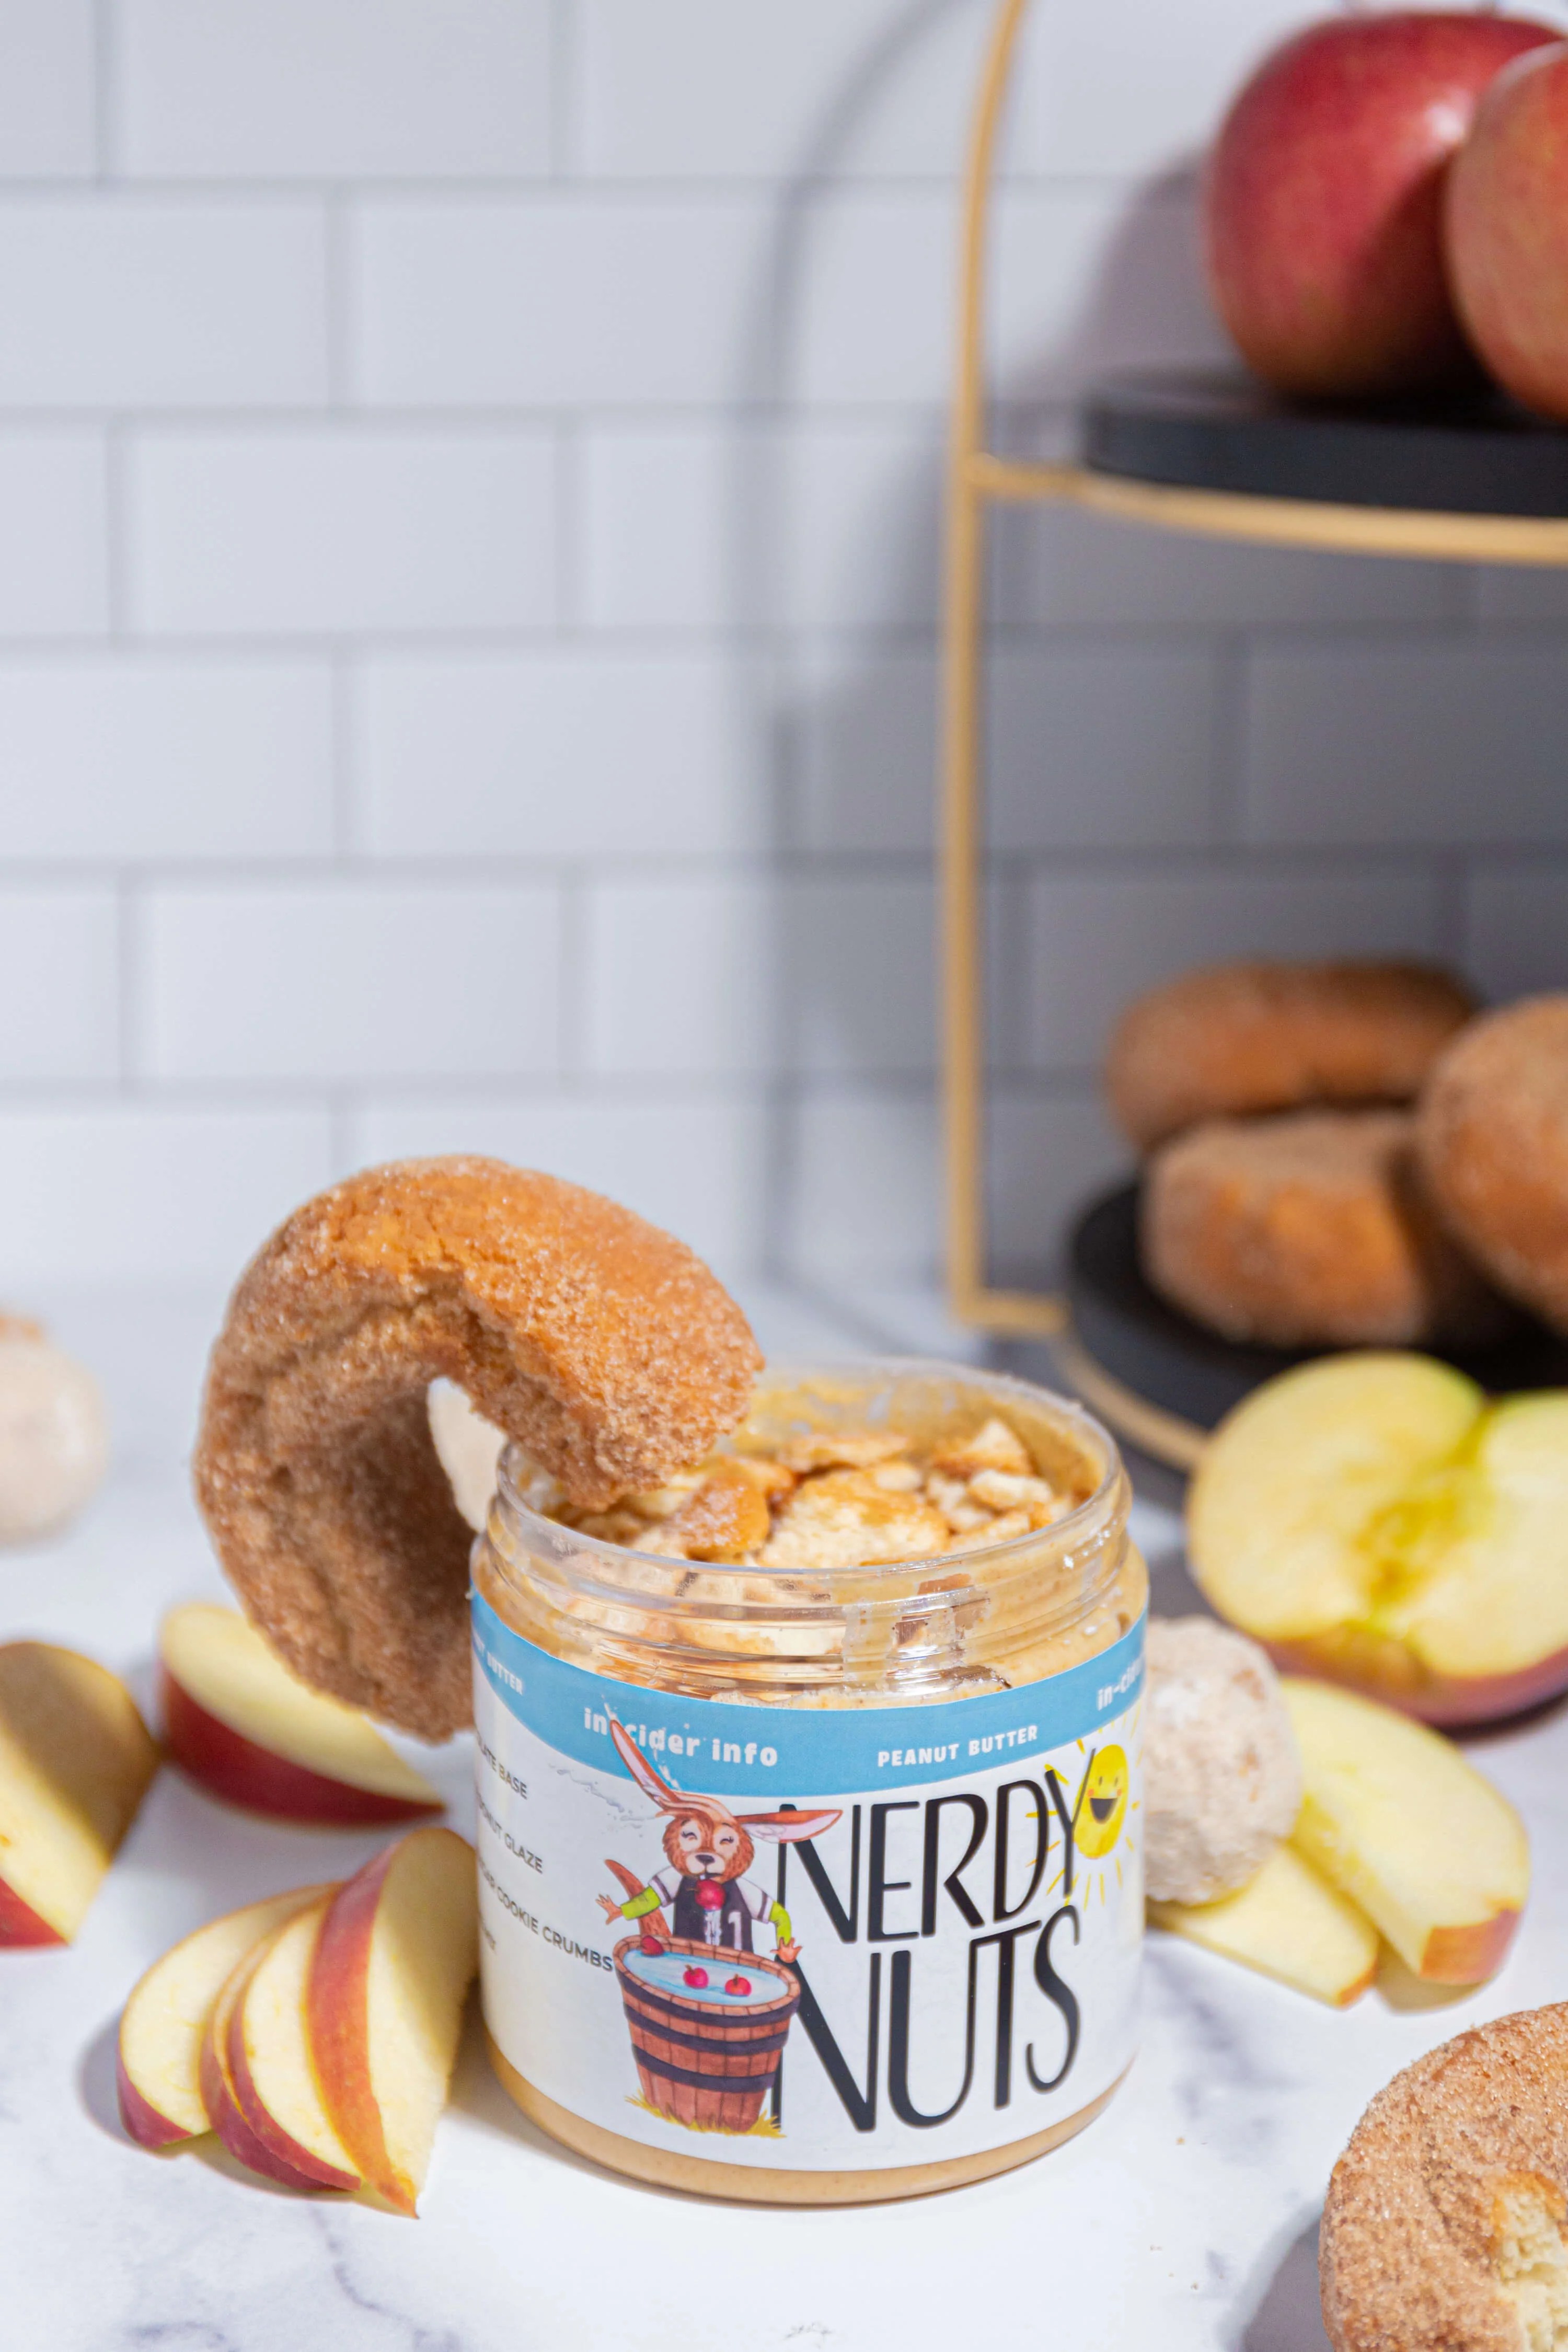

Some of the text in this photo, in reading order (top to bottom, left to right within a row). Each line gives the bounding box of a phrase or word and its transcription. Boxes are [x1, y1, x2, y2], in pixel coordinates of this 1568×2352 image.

[711, 1738, 778, 1767] info
[878, 1725, 1038, 1767] PEANUT BUTTER
[499, 1763, 527, 1800] BASE
[504, 1831, 544, 1875] GLAZE
[776, 1748, 1097, 1944] NERDY
[497, 1886, 539, 1935] COOKIE
[542, 1926, 613, 1973] CRUMBS
[770, 1904, 1080, 2133] NUTS
